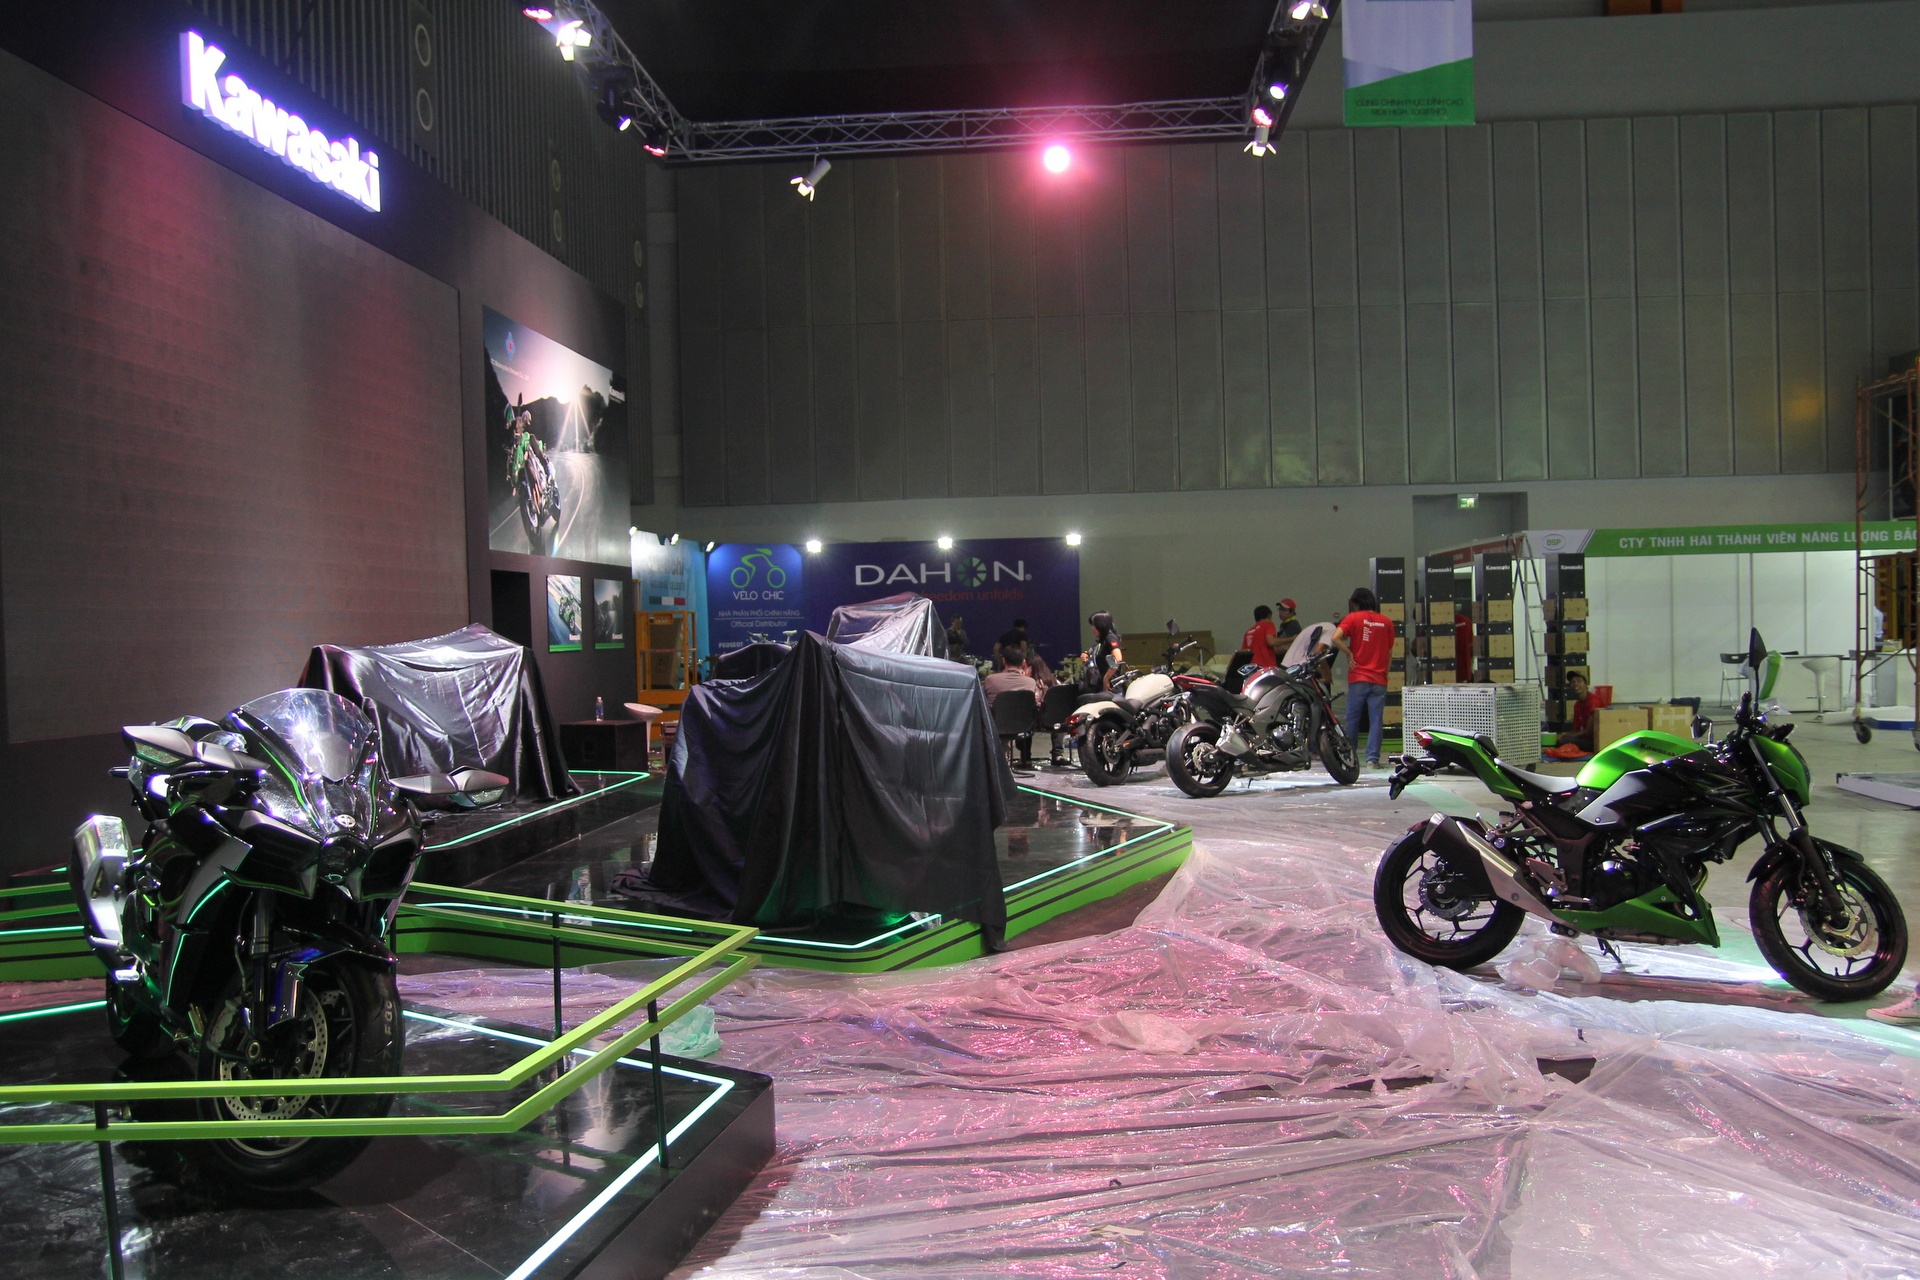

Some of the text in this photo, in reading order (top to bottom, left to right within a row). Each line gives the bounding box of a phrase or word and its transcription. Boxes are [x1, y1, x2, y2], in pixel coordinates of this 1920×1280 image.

[180, 30, 381, 212] Kawasaki
[1619, 537, 1645, 548] CTY
[1649, 535, 1685, 548] TNHH
[1690, 535, 1712, 546] HAI
[1716, 532, 1762, 545] THÀNH
[1766, 531, 1797, 544] VIÊN
[762, 590, 784, 600] CHIC
[977, 588, 1024, 601] unfolds
[730, 620, 787, 628] Official Distributor
